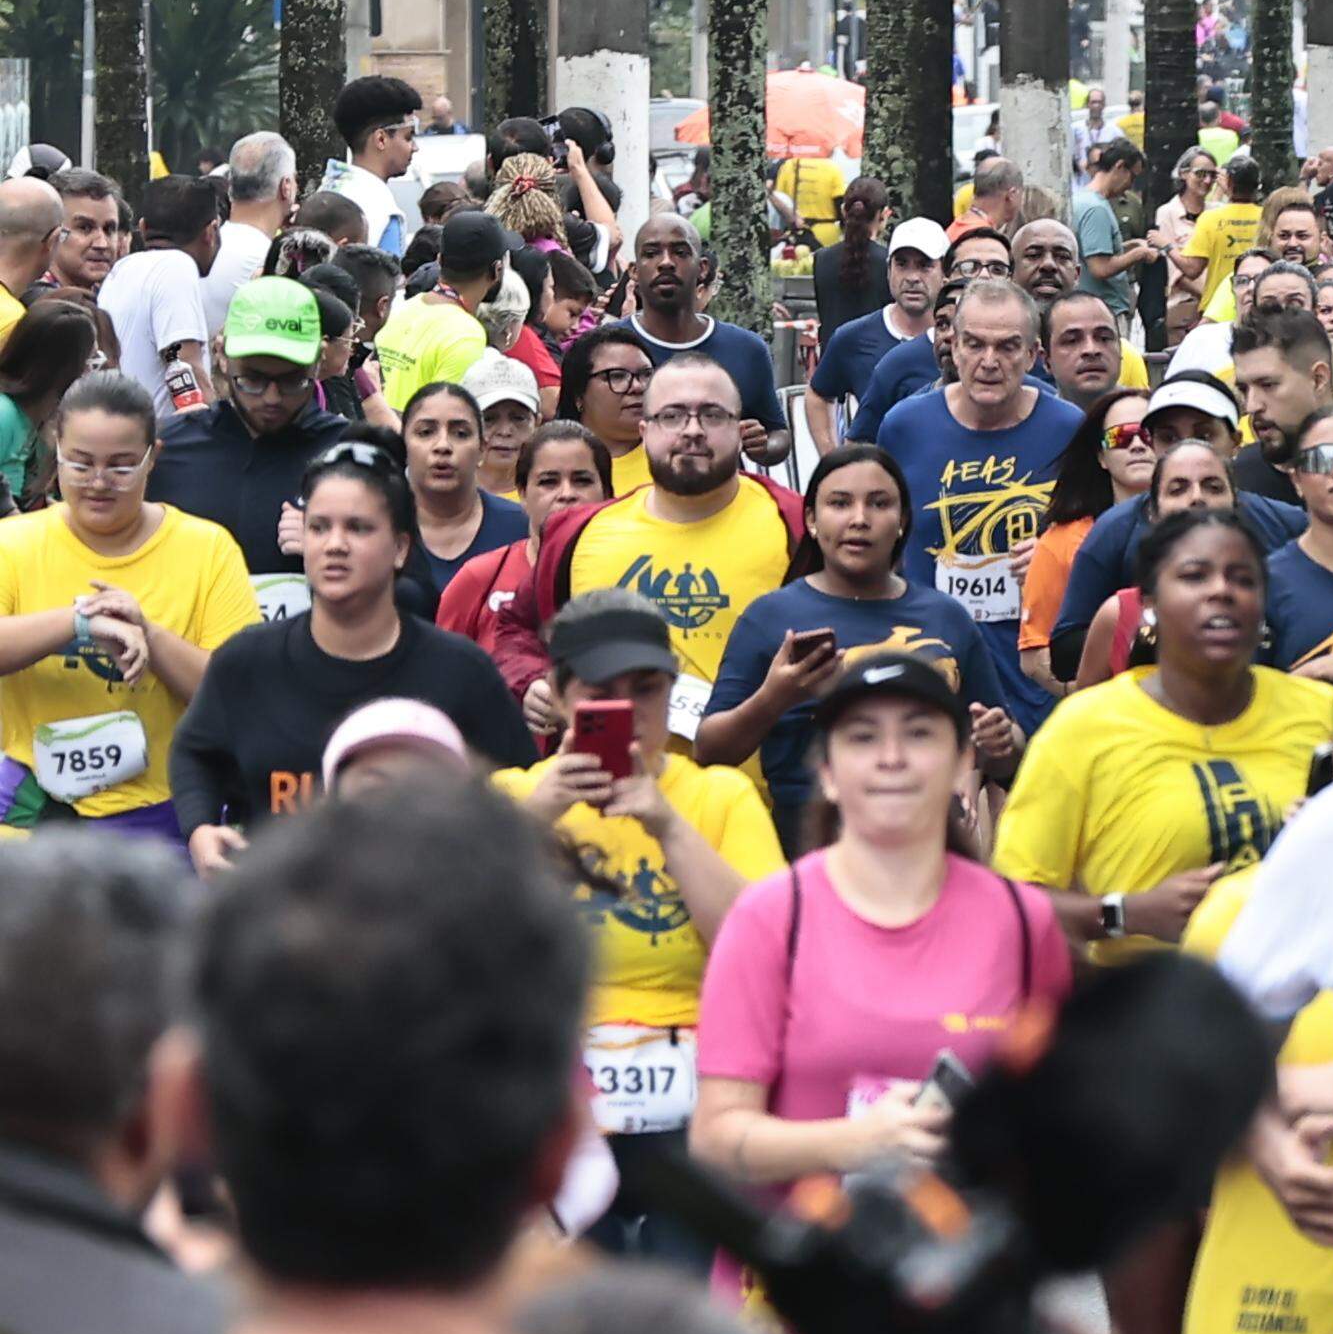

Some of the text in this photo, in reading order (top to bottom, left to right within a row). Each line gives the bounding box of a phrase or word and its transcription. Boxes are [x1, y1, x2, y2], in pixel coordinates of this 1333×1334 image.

[948, 575, 1007, 597] 19614
[51, 744, 122, 776] 7859
[585, 1065, 677, 1095] 3317
